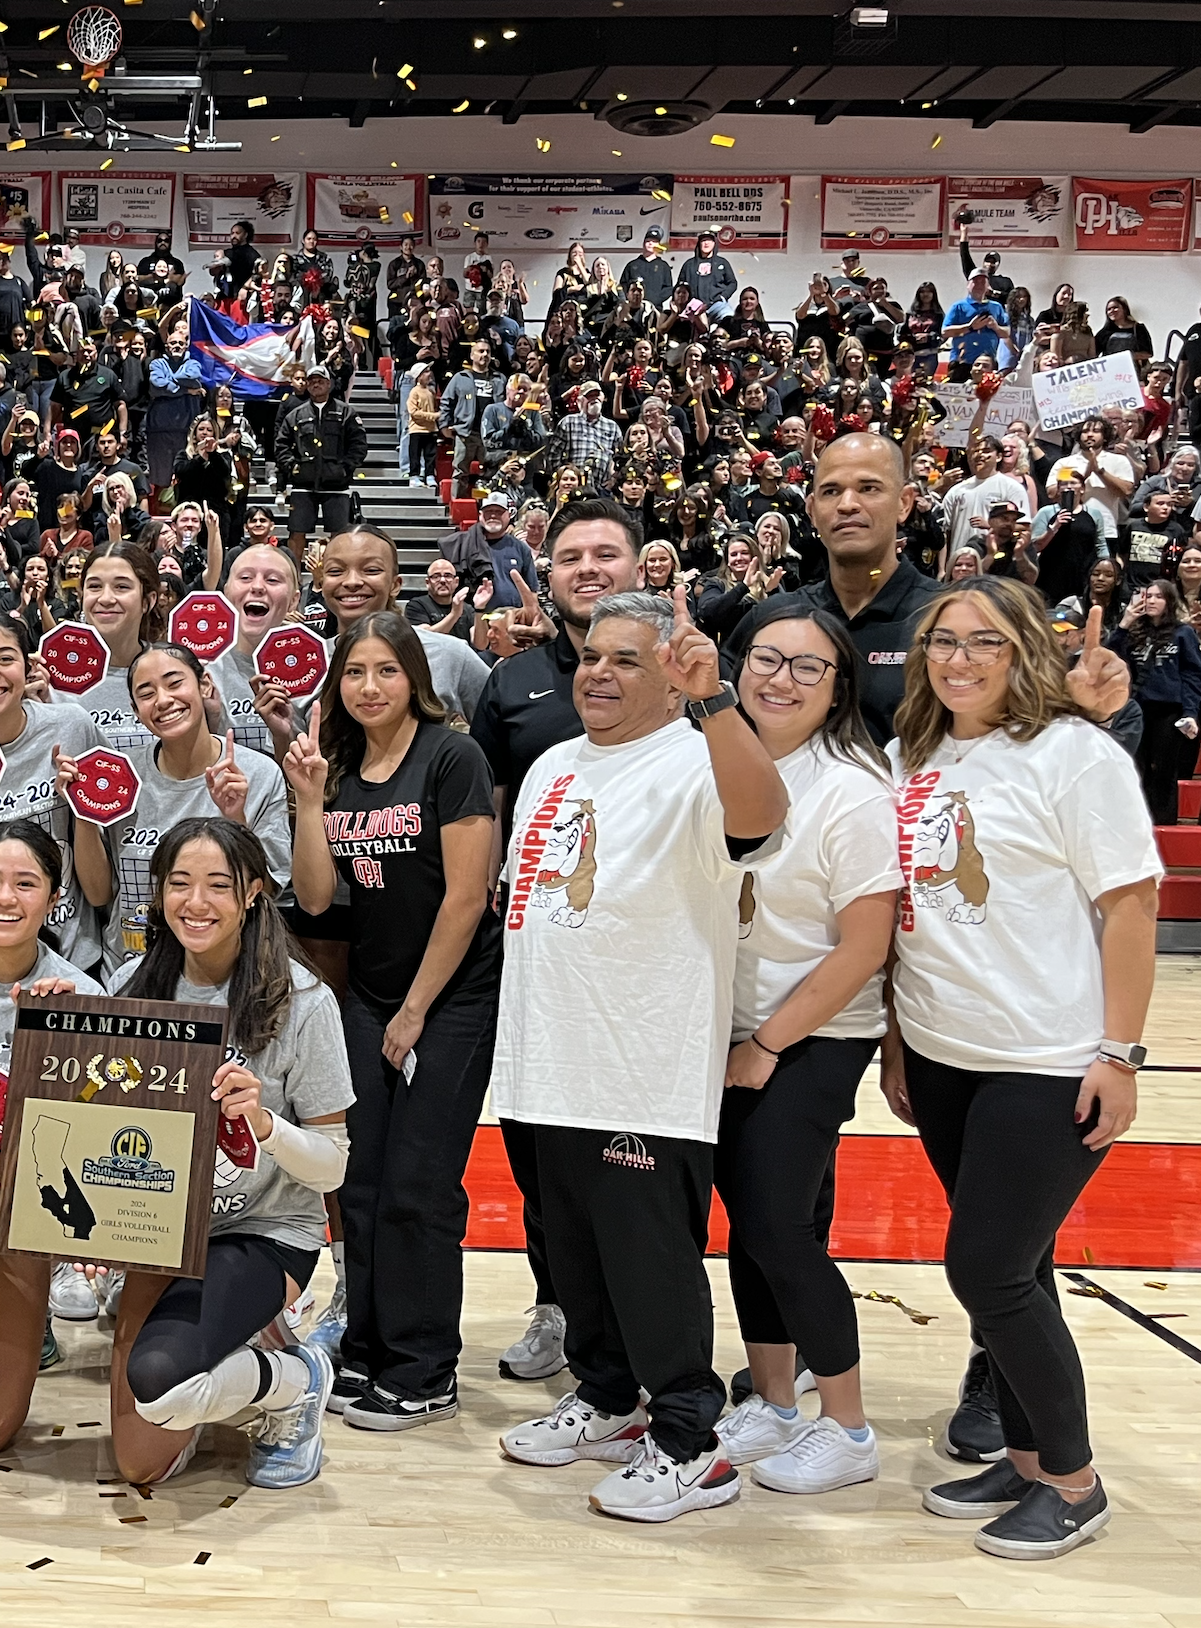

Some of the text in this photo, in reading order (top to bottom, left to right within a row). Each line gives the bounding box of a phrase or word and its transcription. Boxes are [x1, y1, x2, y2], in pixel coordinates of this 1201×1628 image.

[103, 186, 167, 195] La Casita Cafe
[517, 185, 540, 193] support
[694, 188, 763, 198] PAUL BELL DDS
[694, 201, 762, 211] 760-552-8675
[1046, 360, 1107, 386] TALENT
[192, 604, 216, 612] CIF-SS
[179, 622, 227, 630] 20 24
[64, 634, 88, 645] CIF-SS
[181, 635, 224, 651] CHAMPIONS
[275, 637, 300, 648] CIF-SS
[48, 649, 97, 666] 20 24
[265, 653, 317, 670] 20 24
[49, 665, 92, 683] CHAMPIONS
[272, 667, 317, 688] CHAMPIONS
[95, 760, 121, 772] CIF-SS
[78, 773, 128, 796] 20 24
[76, 789, 121, 810] CHAMPIONS
[329, 838, 416, 856] OLLEYBALL
[507, 774, 576, 931] CHAMPIONS
[352, 857, 385, 888] OH
[46, 1012, 197, 1041] CHAMPIONS
[39, 1055, 189, 1094] 20 24
[117, 1132, 146, 1156] CIF
[117, 1157, 143, 1169] Ford
[603, 1148, 655, 1165] OAK HILLS
[84, 1160, 173, 1180] Southern Section
[83, 1172, 172, 1191] CHAMPIONSHIPS
[117, 1209, 152, 1218] DIVISION
[124, 1222, 171, 1233] VOLLEYBALL
[111, 1234, 158, 1244] CHAMPIONS
